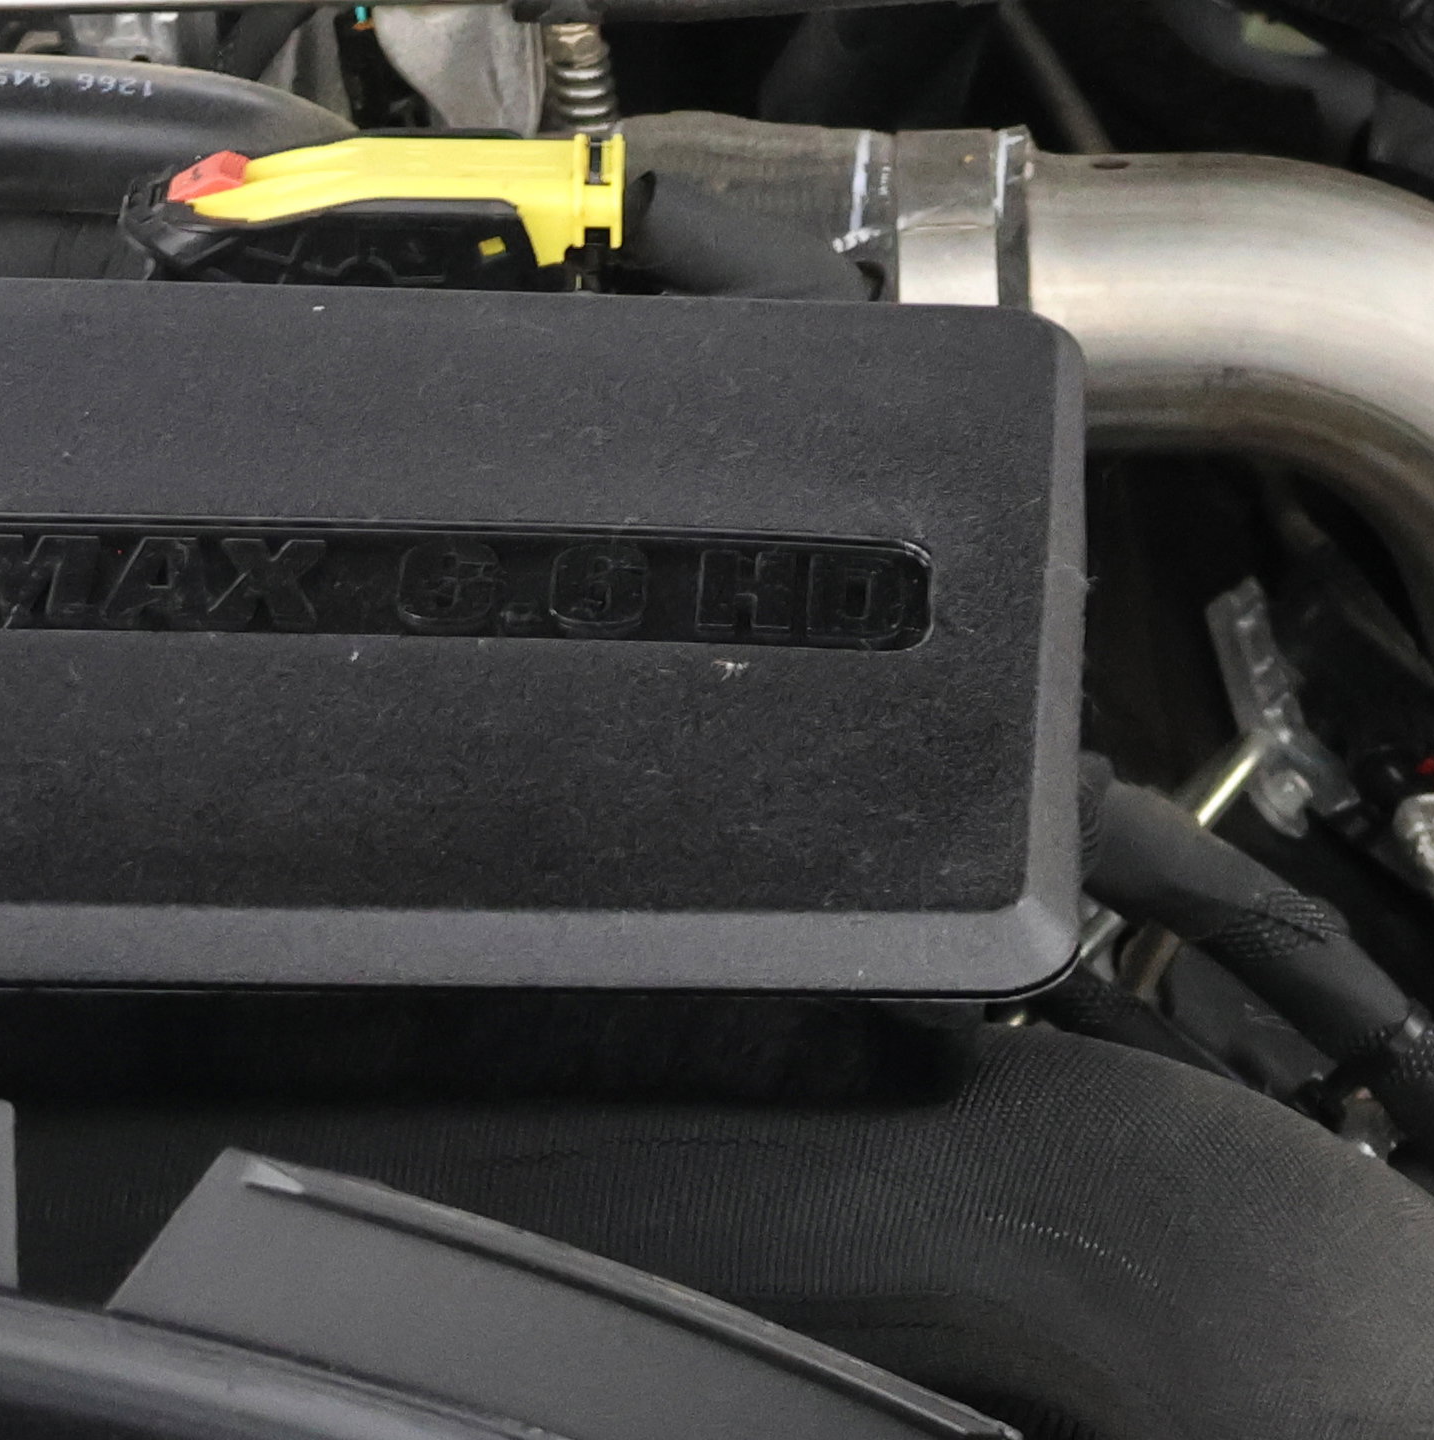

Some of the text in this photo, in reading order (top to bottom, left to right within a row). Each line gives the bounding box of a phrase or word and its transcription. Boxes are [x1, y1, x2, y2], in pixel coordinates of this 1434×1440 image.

[77, 73, 154, 98] 1266
[396, 539, 648, 636] 6.6
[693, 546, 910, 643] HD
